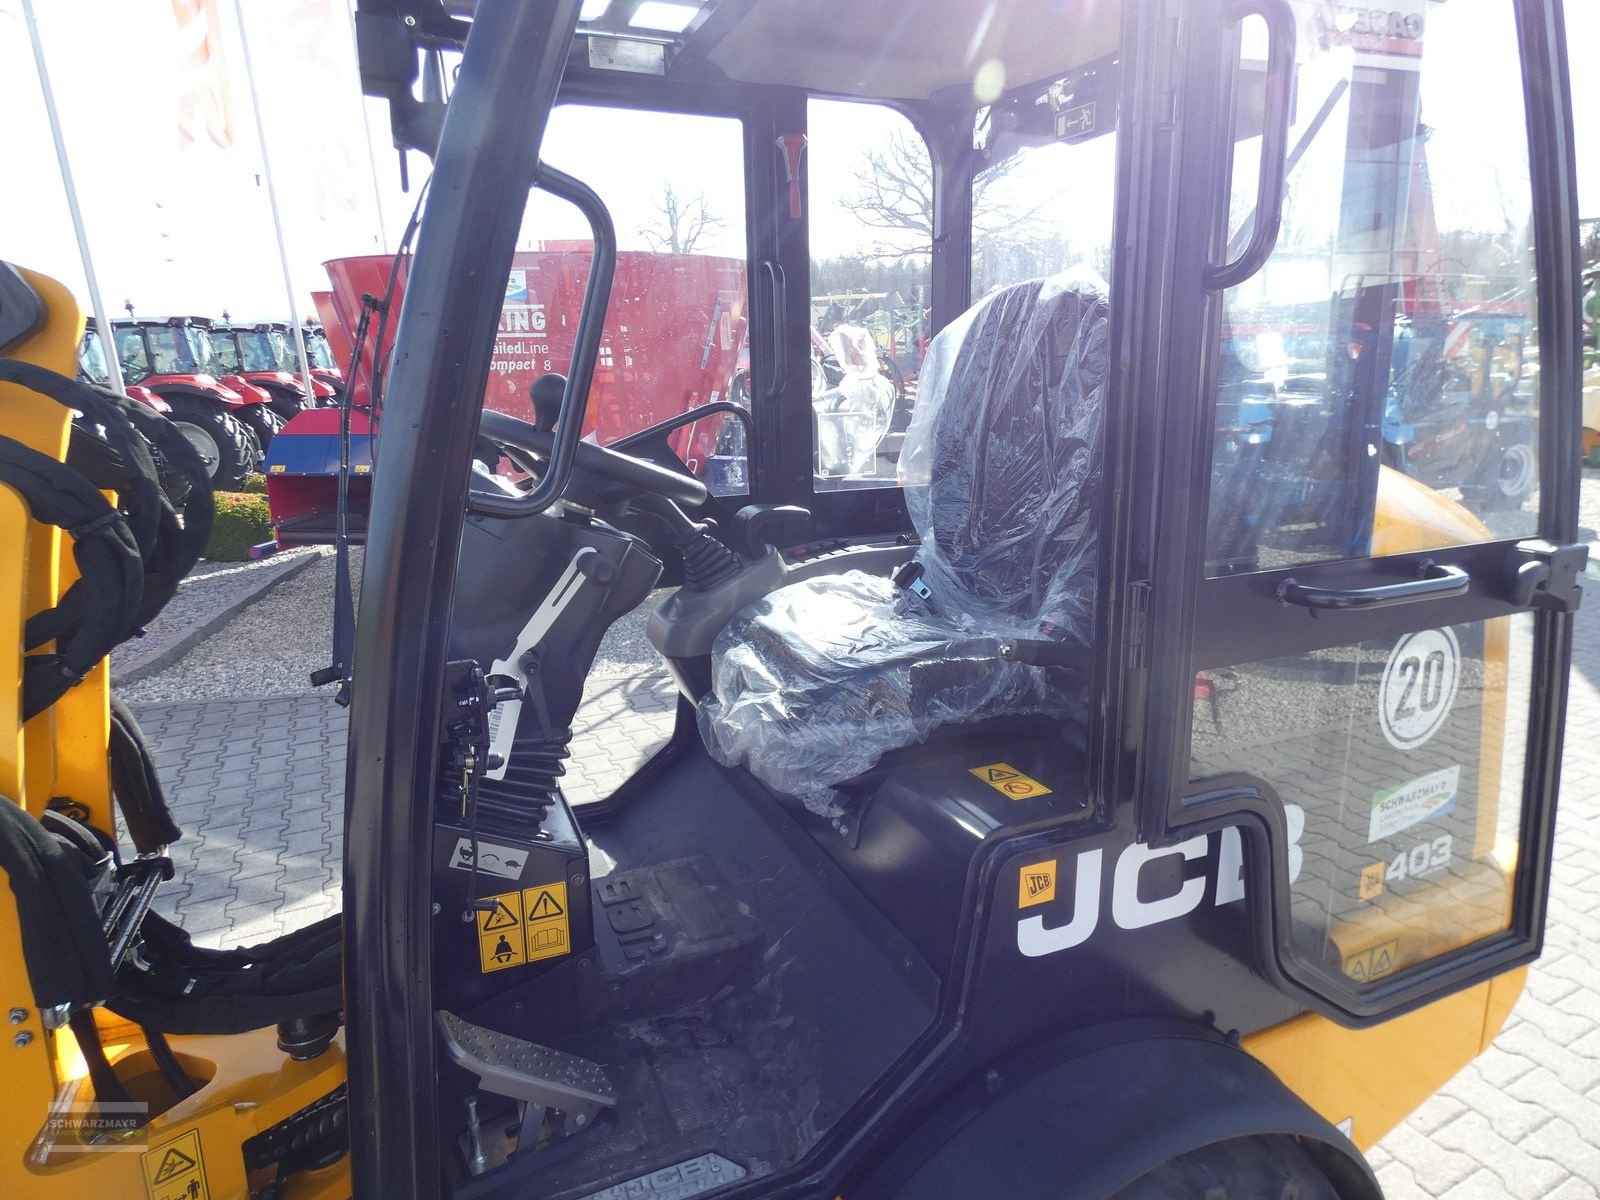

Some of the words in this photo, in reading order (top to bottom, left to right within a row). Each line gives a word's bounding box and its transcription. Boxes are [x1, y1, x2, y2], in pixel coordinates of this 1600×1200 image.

[543, 360, 552, 371] 8
[1394, 650, 1445, 721] 20
[1379, 781, 1447, 813] SCHWARZMAYR
[1386, 834, 1453, 881] 403
[1029, 872, 1051, 894] JCB
